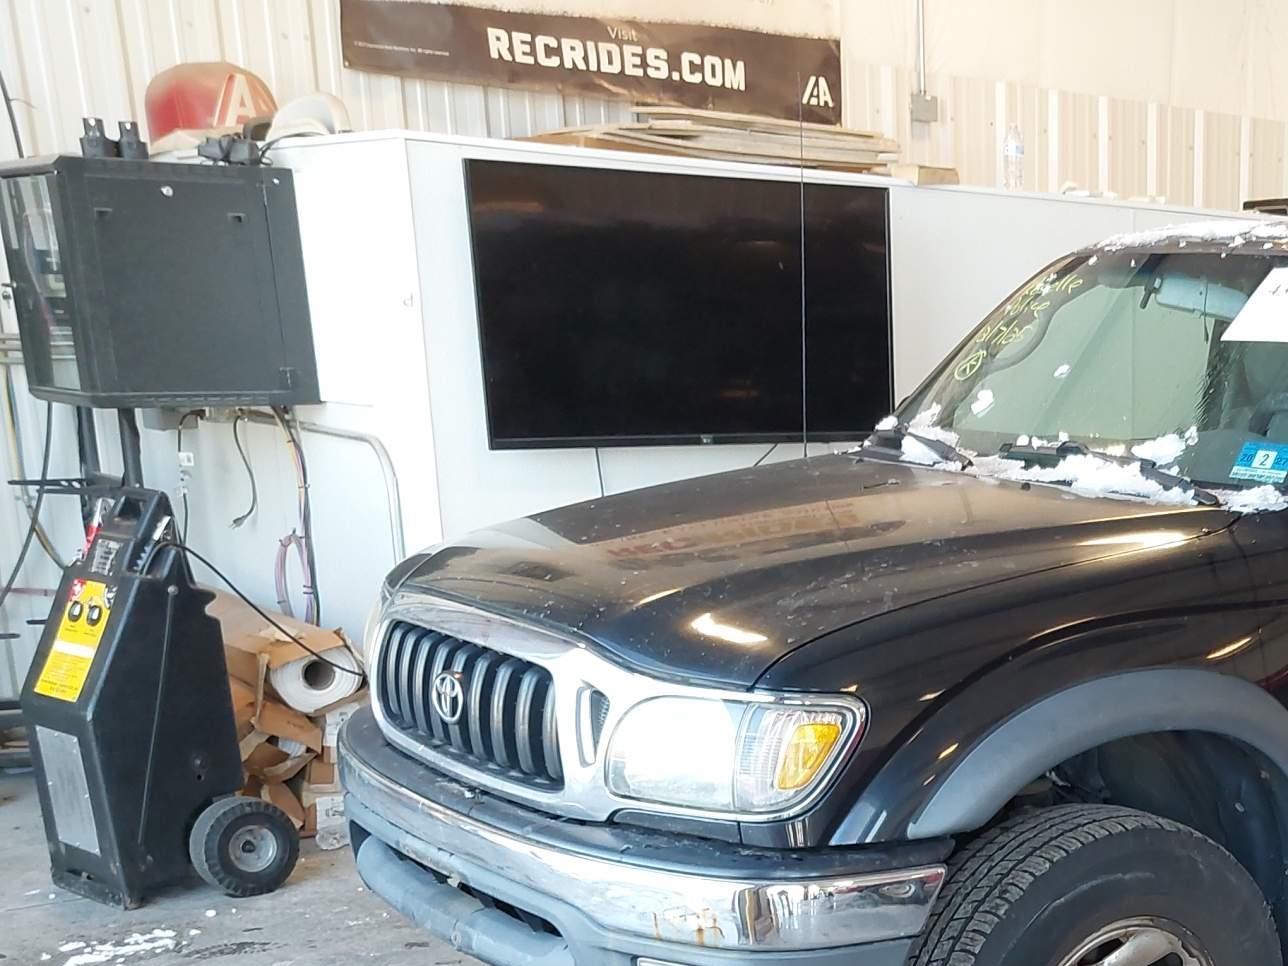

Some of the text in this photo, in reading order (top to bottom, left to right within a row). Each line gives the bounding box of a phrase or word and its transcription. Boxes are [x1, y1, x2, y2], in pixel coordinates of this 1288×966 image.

[607, 26, 639, 42] Visit
[486, 27, 746, 91] RECRIDES.COM
[1259, 453, 1270, 466] 2
